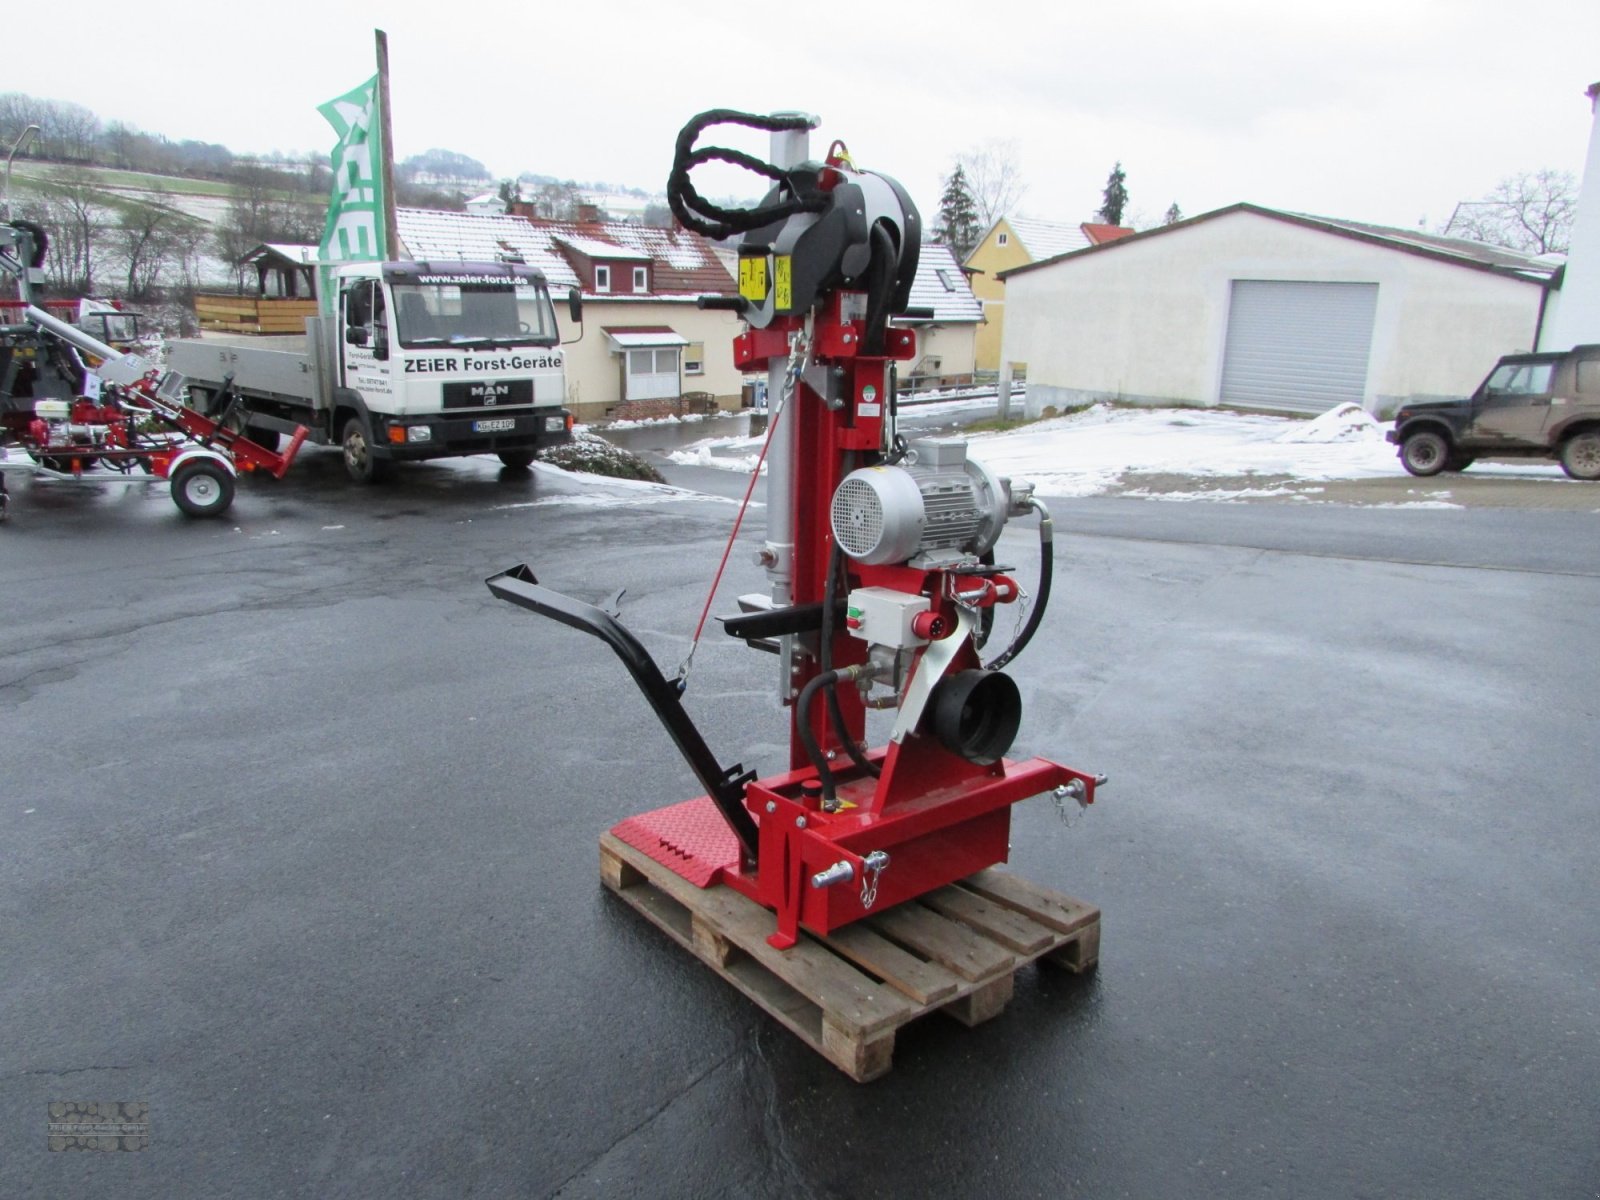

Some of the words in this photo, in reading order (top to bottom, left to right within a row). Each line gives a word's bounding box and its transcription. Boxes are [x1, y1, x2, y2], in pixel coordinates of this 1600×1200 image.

[418, 274, 528, 285] www.zeier-forst.de
[464, 355, 562, 371] Forst-Geräte
[471, 385, 508, 396] MAN
